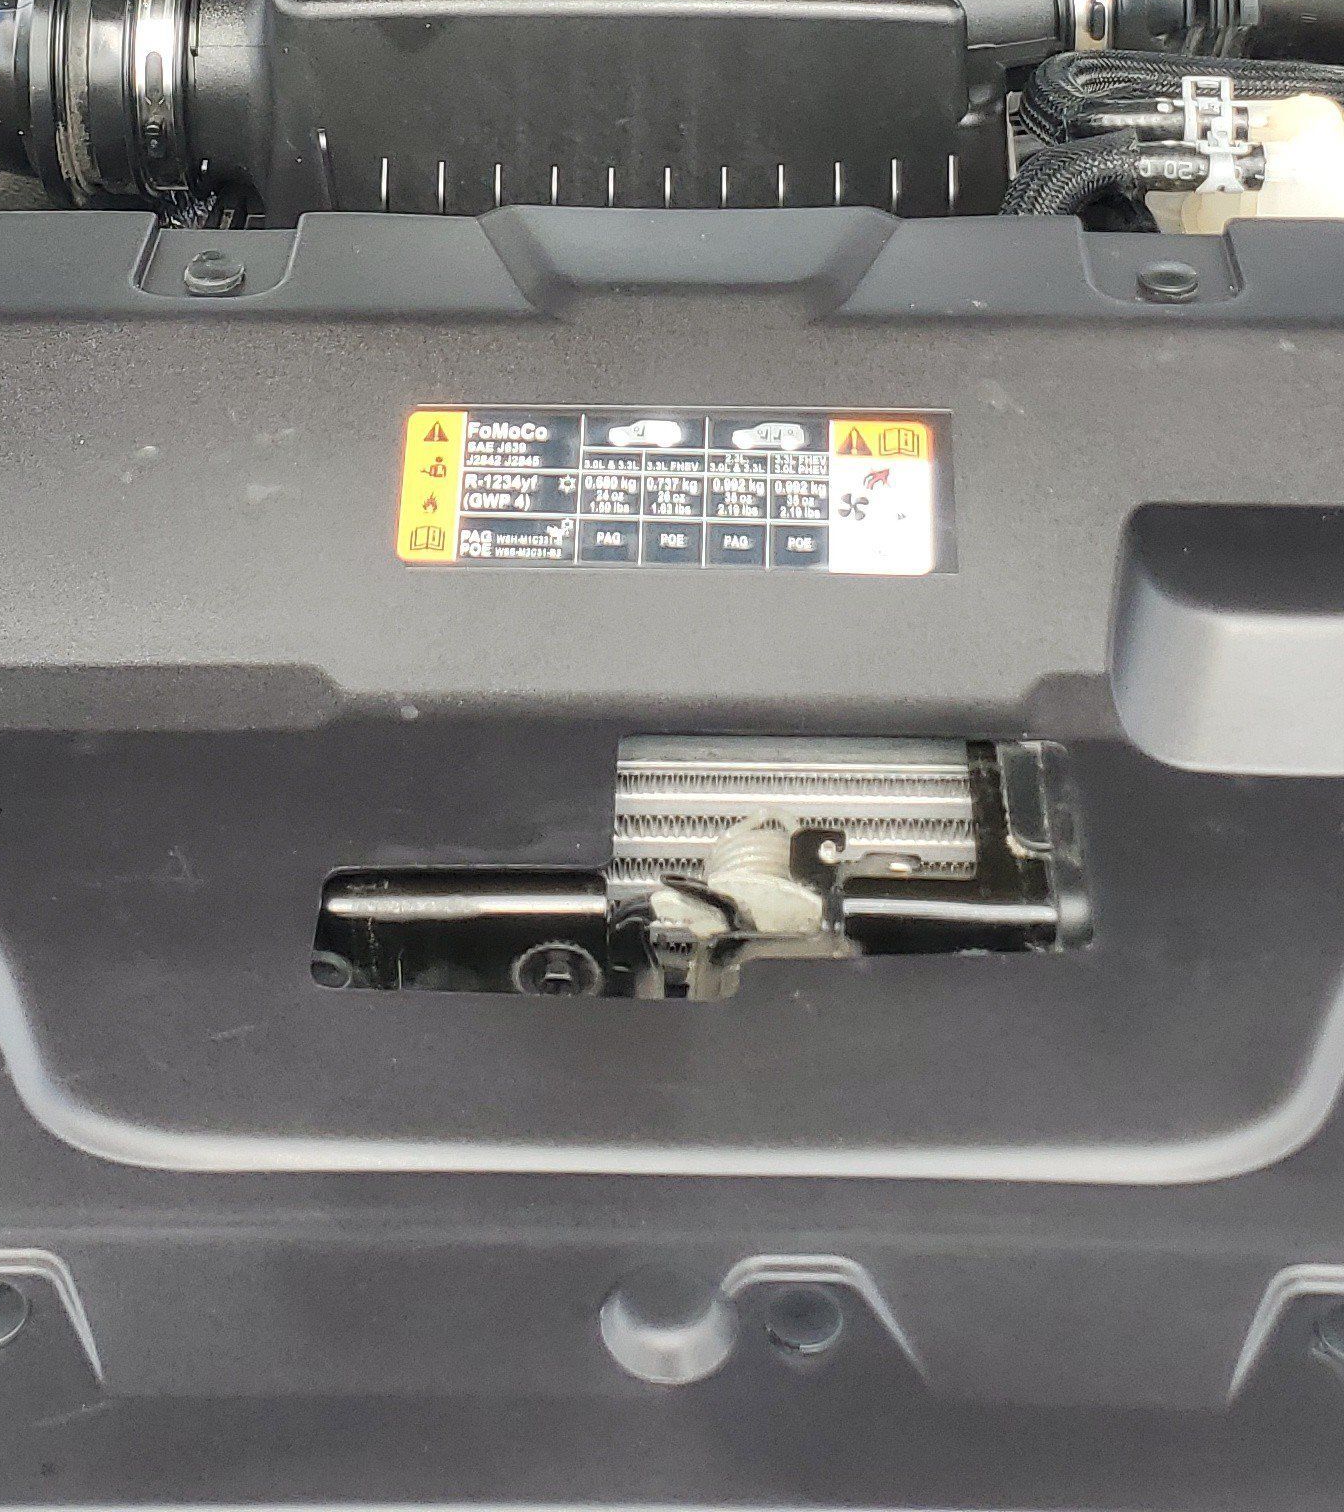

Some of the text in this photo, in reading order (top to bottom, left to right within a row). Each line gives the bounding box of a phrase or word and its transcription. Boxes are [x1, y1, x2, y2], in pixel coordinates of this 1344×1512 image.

[467, 421, 548, 440] FoMoCo
[467, 442, 495, 453] SAE
[465, 473, 538, 492] R-1234yf
[621, 476, 637, 494] kg
[682, 477, 698, 496] kg
[749, 478, 765, 497] kg
[811, 481, 827, 499] kg
[463, 493, 531, 511] (GWP 4)
[613, 501, 630, 514] lbs
[675, 503, 692, 515] lbs
[741, 504, 758, 516] lbs
[804, 506, 820, 519] lbs
[460, 530, 492, 543] PAG
[596, 532, 621, 546] PAG
[660, 533, 686, 548] POE
[723, 535, 749, 548] PAG
[460, 543, 492, 557] POE
[787, 537, 813, 551] POE
